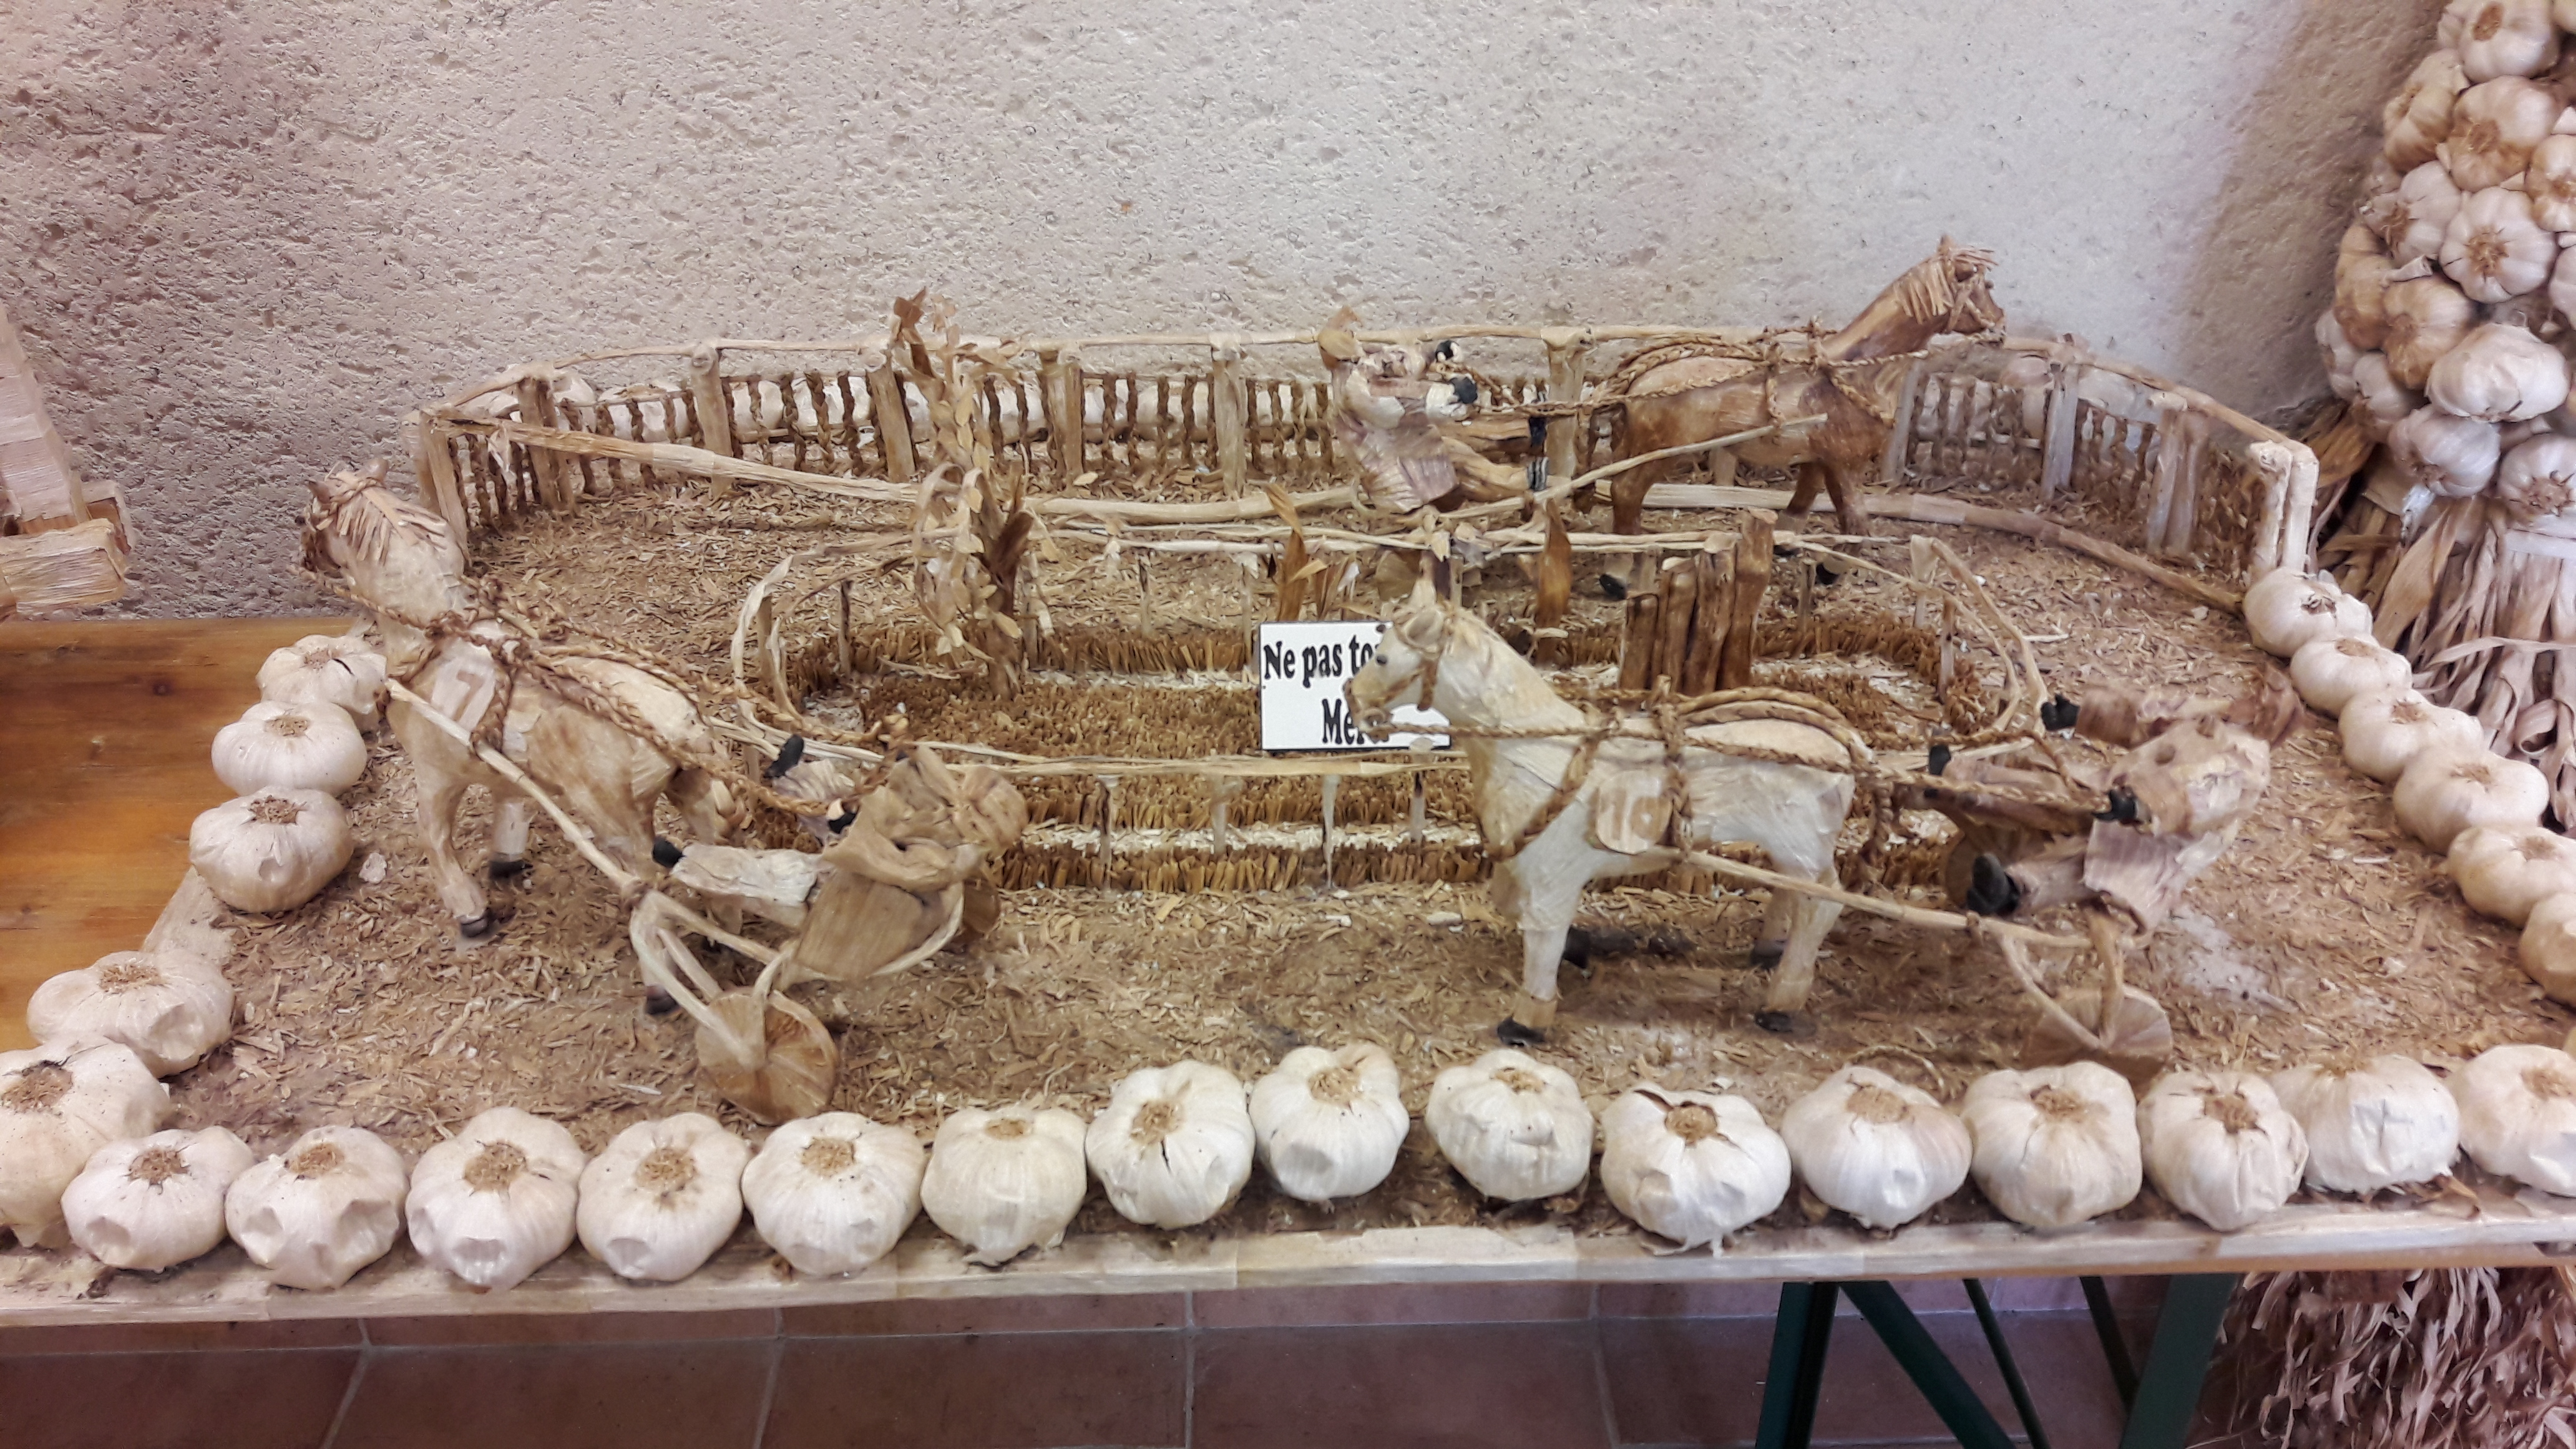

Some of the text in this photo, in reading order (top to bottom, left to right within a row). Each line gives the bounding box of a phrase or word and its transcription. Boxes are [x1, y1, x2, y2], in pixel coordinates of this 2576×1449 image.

[1264, 635, 1380, 688] Ne pas to
